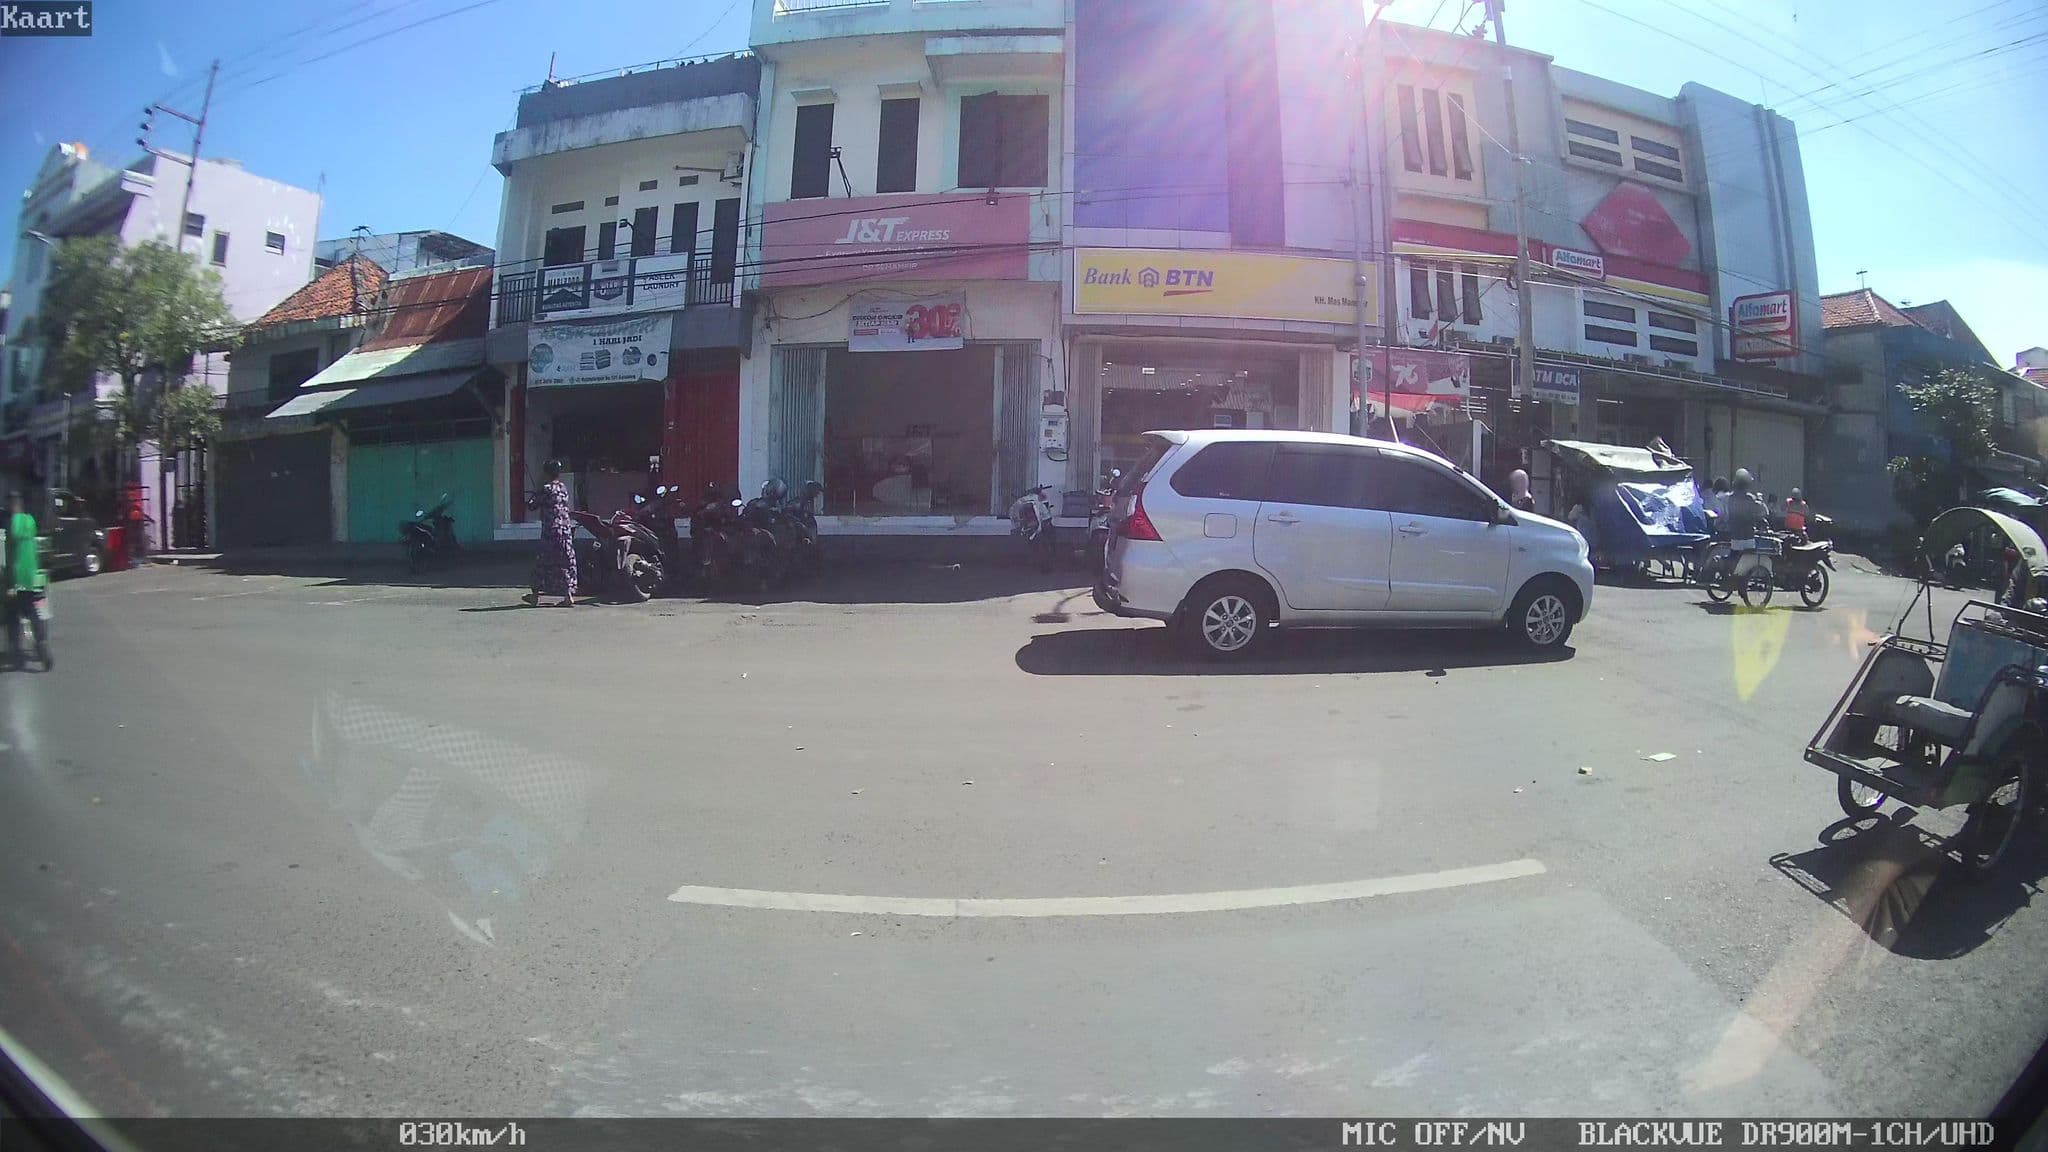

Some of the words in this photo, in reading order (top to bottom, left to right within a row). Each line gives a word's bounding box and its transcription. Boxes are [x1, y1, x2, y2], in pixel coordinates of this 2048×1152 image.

[834, 217, 910, 244] J&T
[896, 230, 950, 241] EXPRESS
[1555, 250, 1602, 269] Alfamart
[1084, 267, 1132, 285] Bank
[1165, 269, 1214, 287] BTN
[1327, 296, 1341, 306] Mas
[1738, 299, 1788, 318] Alfamart
[599, 336, 621, 346] HARI
[623, 334, 642, 344] JADI
[1555, 372, 1577, 387] BCA
